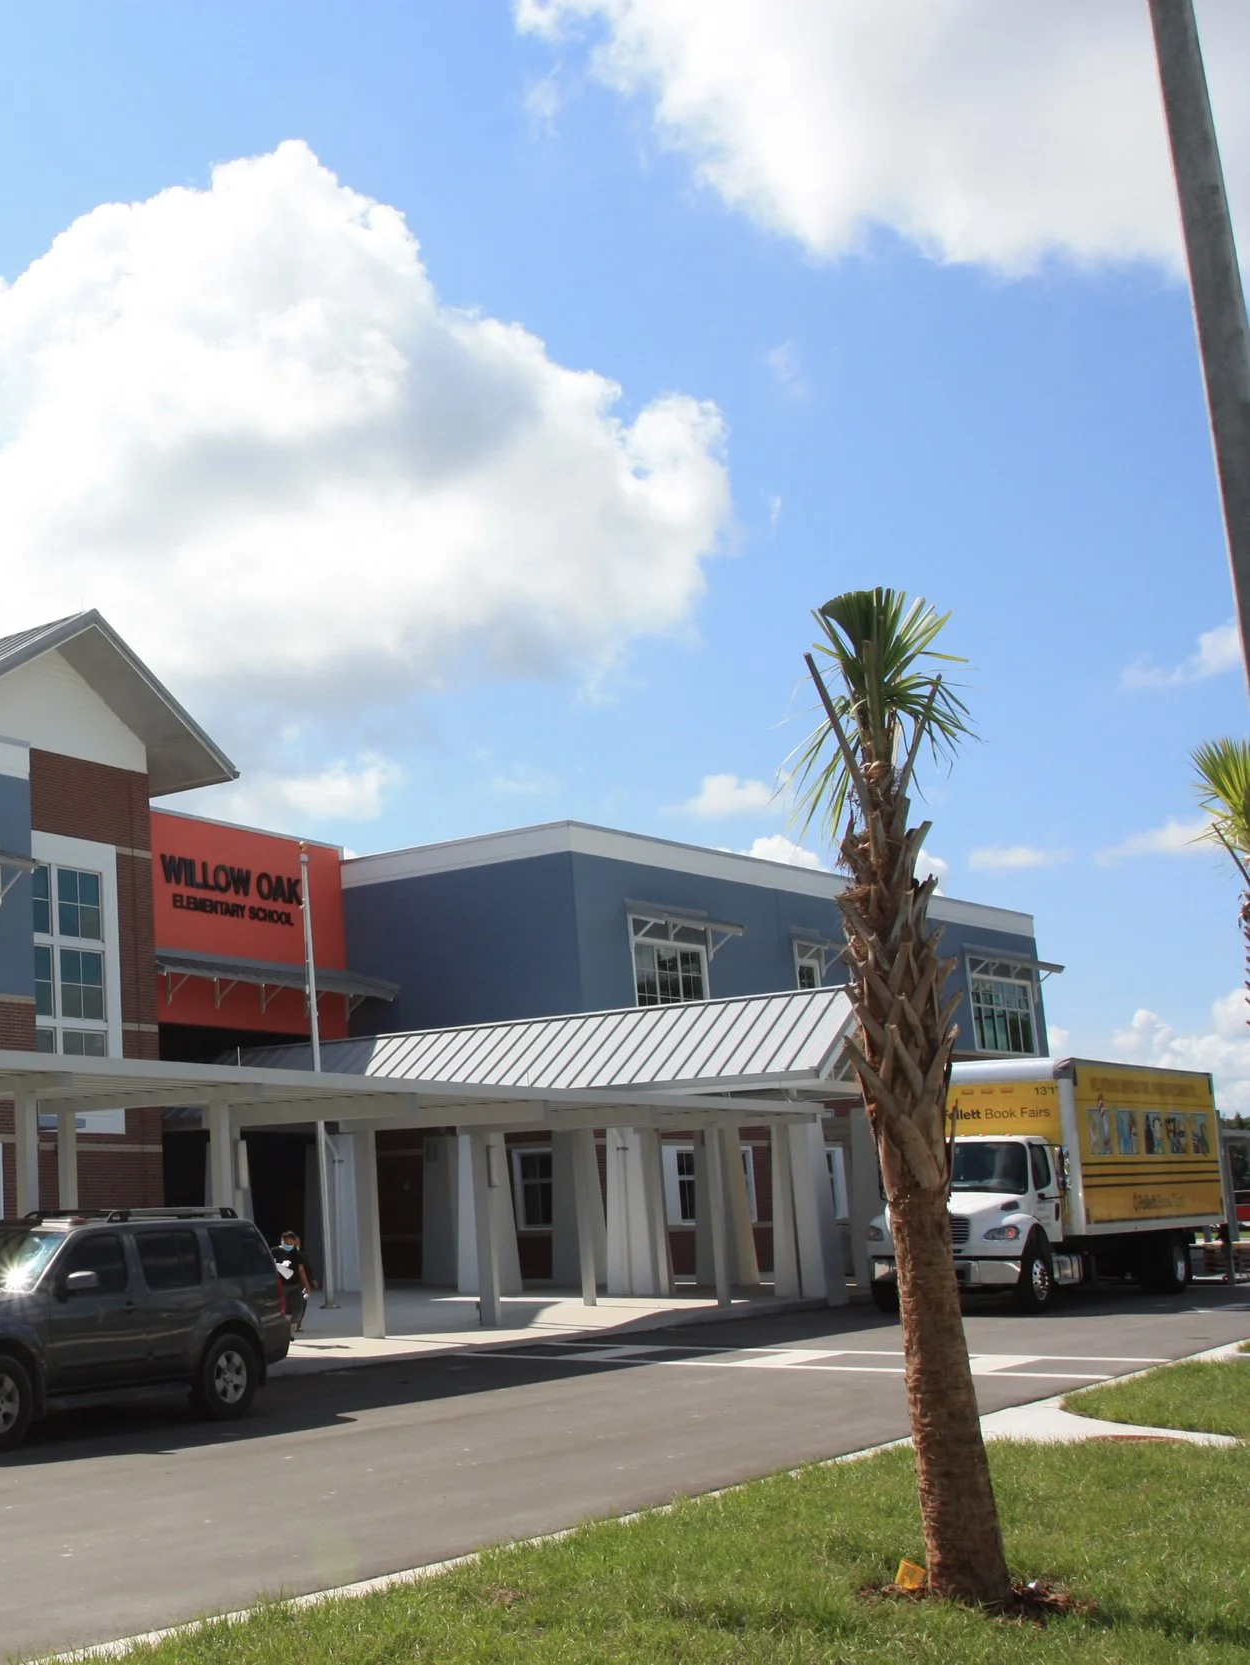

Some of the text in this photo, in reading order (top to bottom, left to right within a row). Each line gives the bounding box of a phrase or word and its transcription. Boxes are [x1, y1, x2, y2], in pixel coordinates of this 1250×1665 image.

[160, 854, 303, 906] WILLOW OAK
[172, 893, 294, 926] ELEMENTARY SCHOOL
[985, 1108, 1016, 1119] Book
[1020, 1106, 1050, 1118] Fairs
